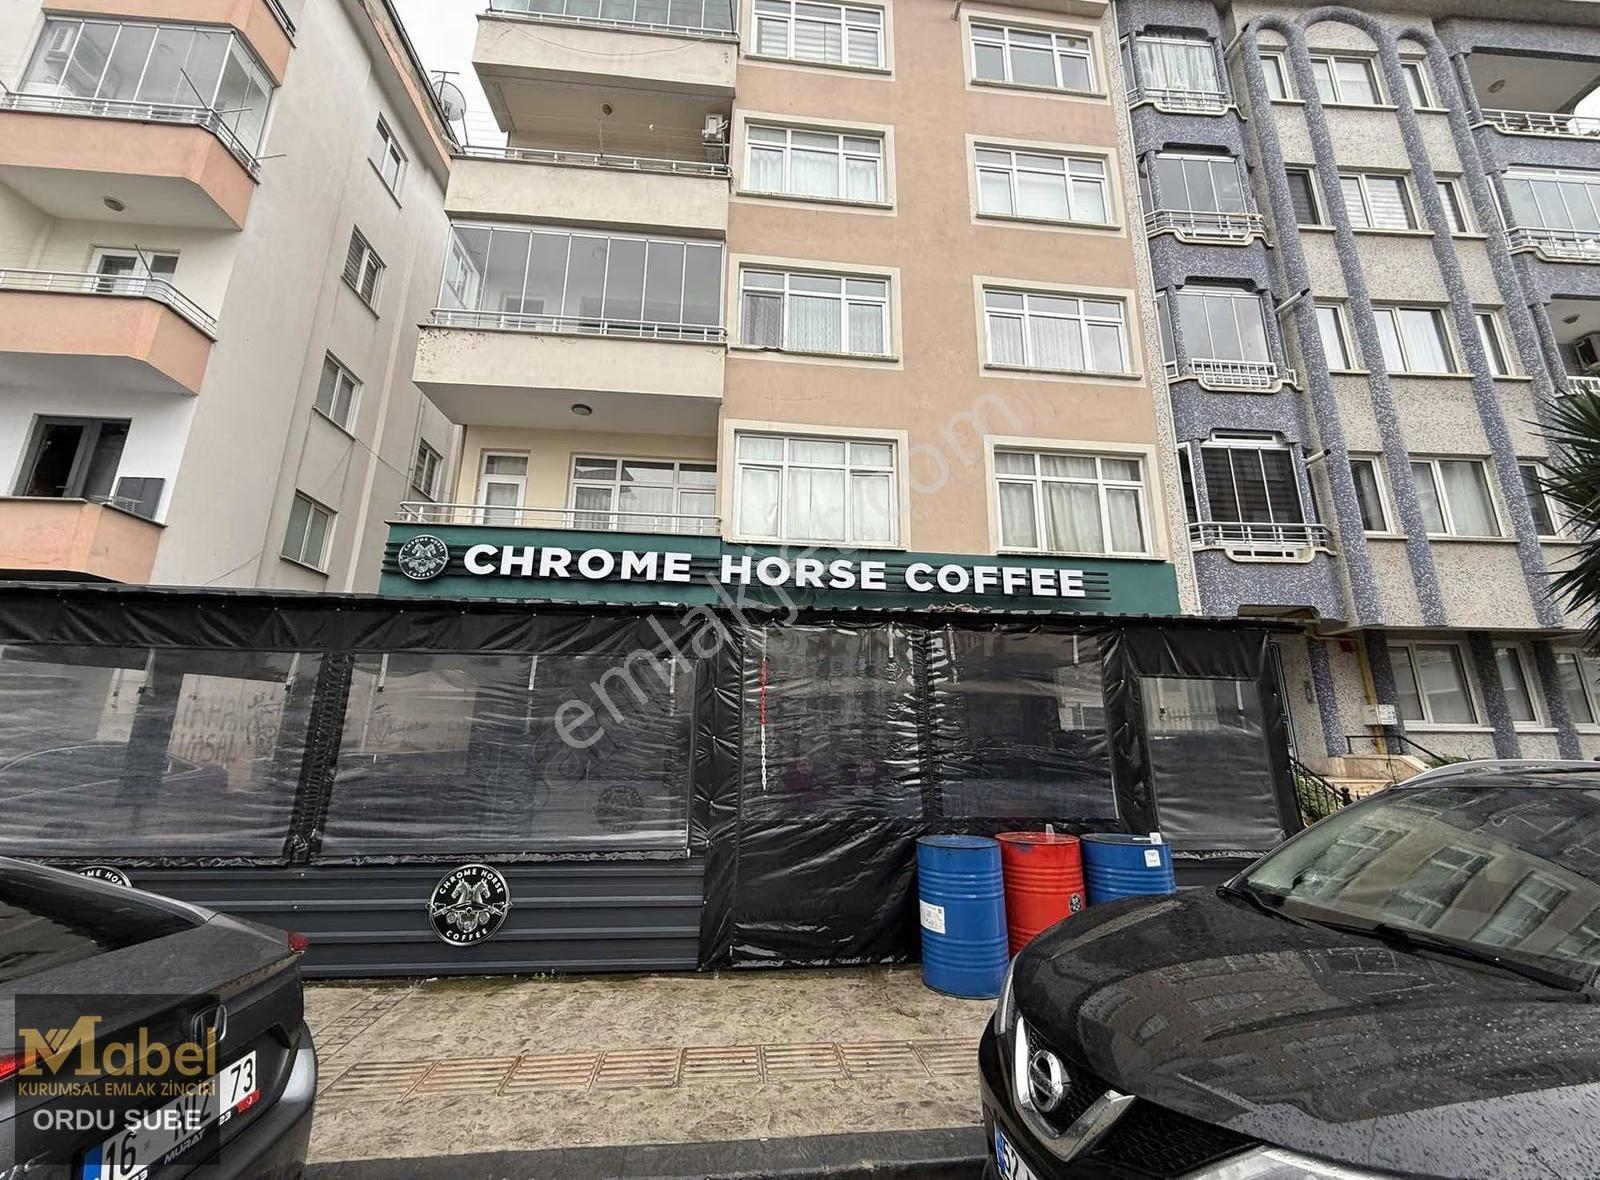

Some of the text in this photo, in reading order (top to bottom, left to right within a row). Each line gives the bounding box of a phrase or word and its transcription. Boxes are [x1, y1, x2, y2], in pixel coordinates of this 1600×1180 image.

[463, 543, 1086, 597] CHROME HORSE COFFEE
[439, 868, 504, 895] CHROME HORSE
[446, 928, 488, 941] COFFEE
[105, 1131, 137, 1180] 16
[231, 1058, 253, 1104] 73
[163, 1127, 206, 1165] MURAT
